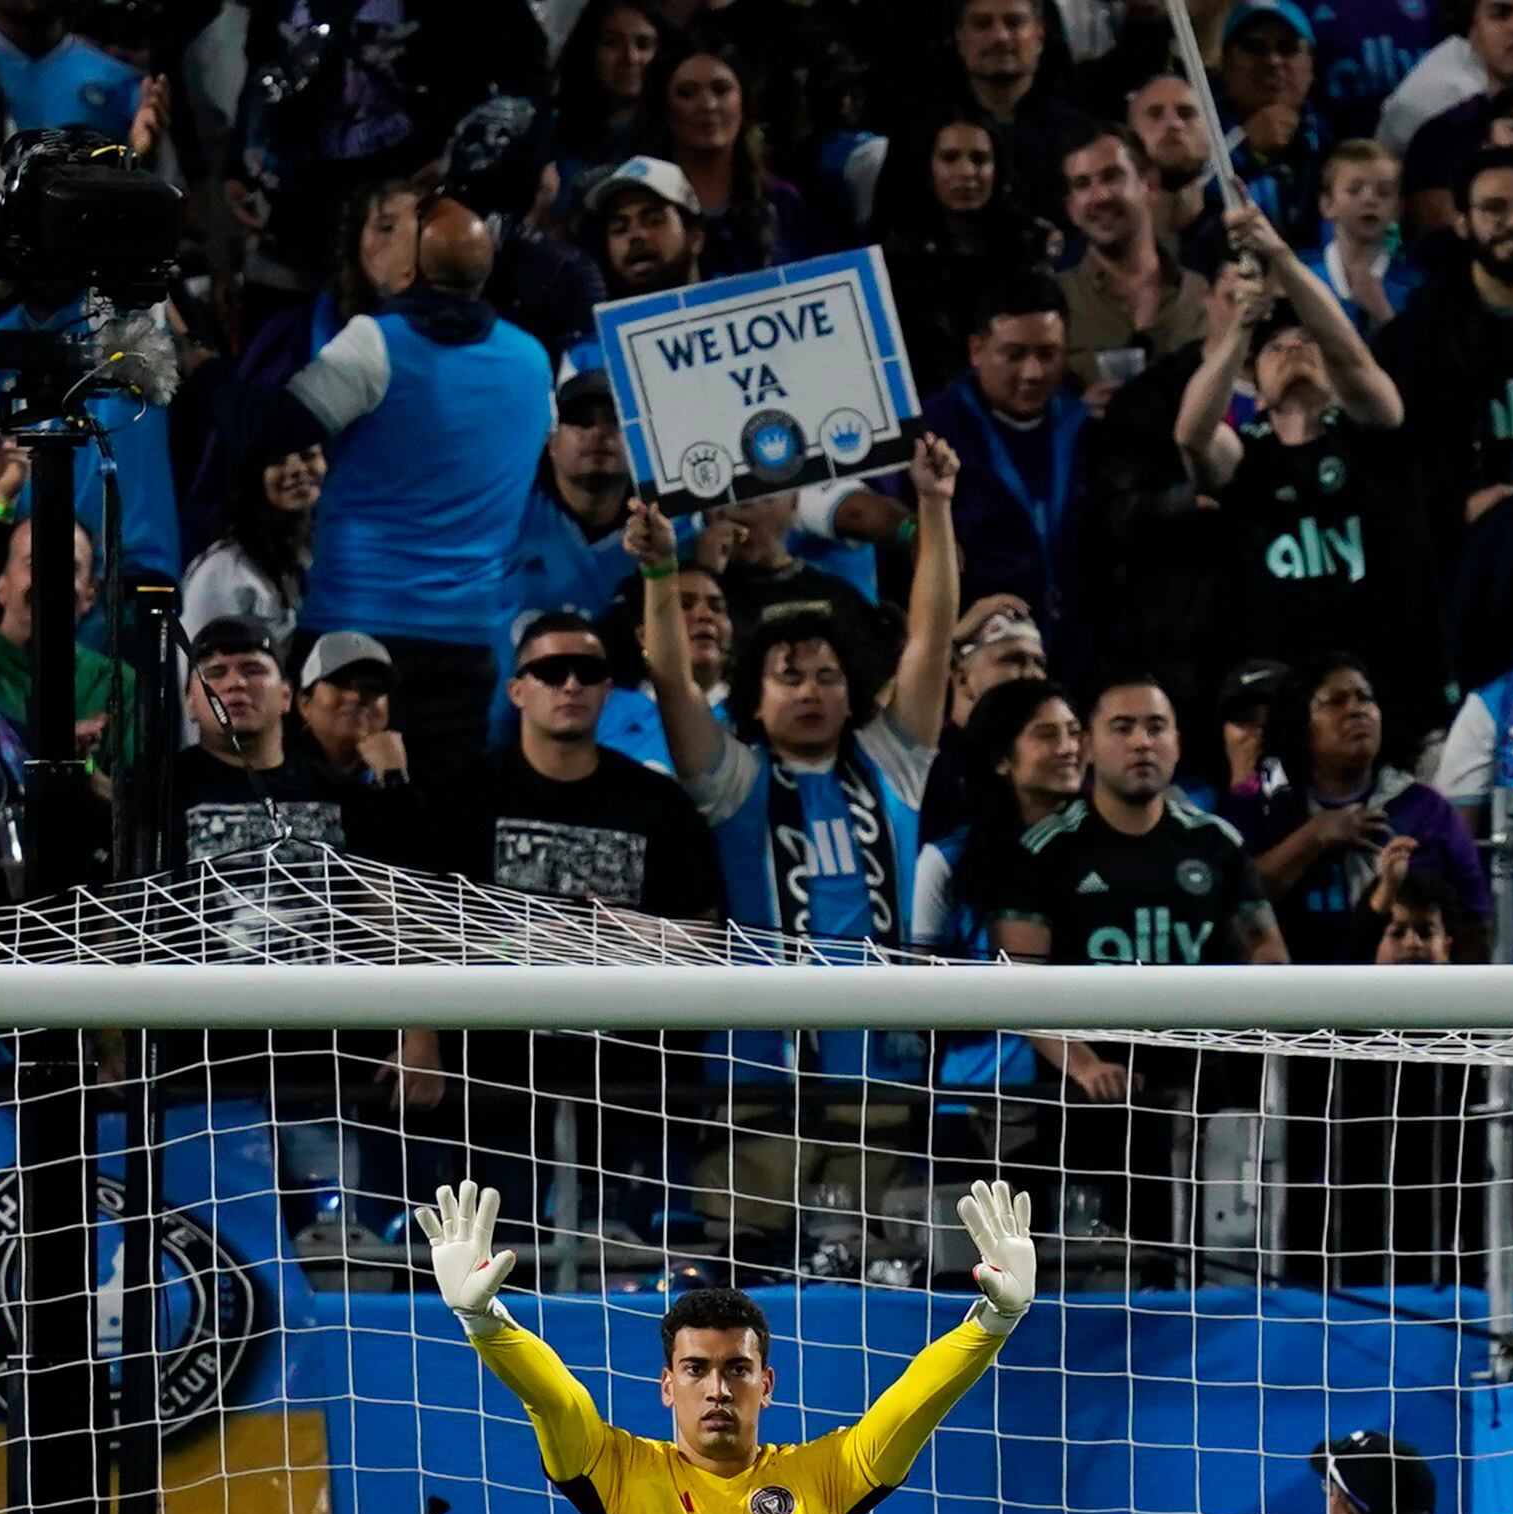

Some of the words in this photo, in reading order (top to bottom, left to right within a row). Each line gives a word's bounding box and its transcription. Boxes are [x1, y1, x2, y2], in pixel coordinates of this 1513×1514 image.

[657, 331, 722, 372] WE
[729, 301, 834, 357] LOVE
[730, 364, 788, 405] YA
[1265, 514, 1367, 584] ally
[1086, 905, 1216, 964] ally
[160, 1350, 223, 1418] CLUB
